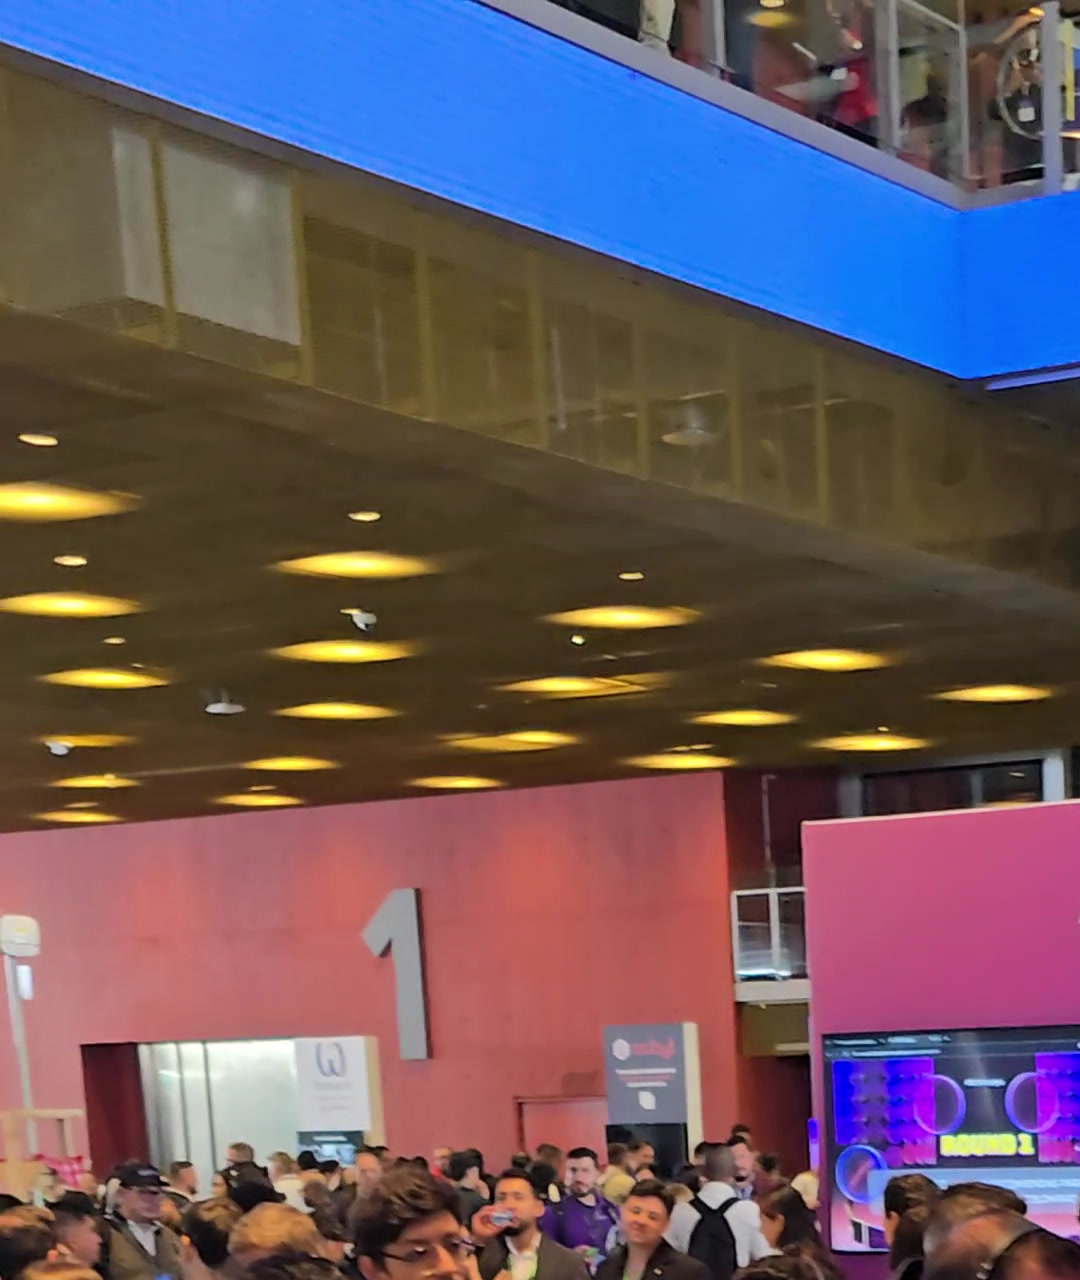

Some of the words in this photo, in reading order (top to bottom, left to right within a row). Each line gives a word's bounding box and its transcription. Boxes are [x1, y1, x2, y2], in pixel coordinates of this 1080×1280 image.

[361, 888, 432, 1060] 1
[940, 1133, 1018, 1157] ROUND
[1017, 1132, 1036, 1156] 1
